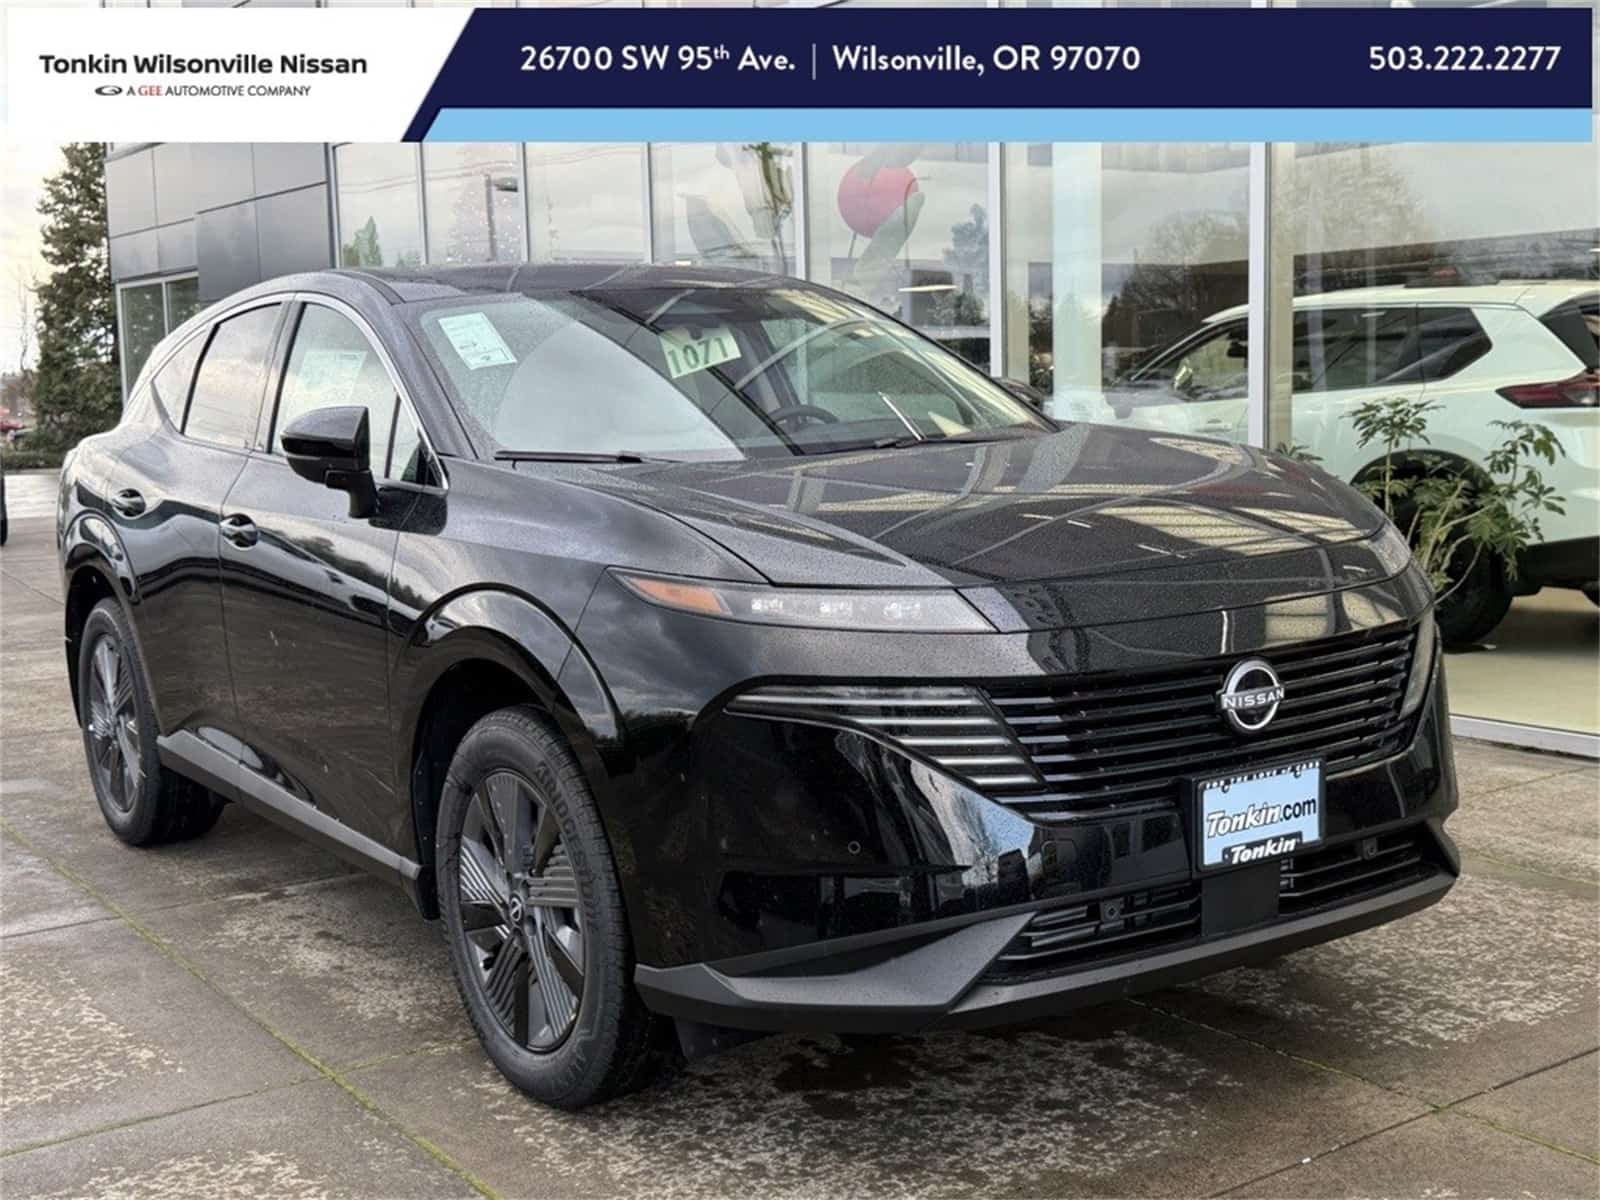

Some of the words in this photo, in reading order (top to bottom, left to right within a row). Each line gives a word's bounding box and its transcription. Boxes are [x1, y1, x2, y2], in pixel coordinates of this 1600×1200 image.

[667, 338, 731, 376] 1071
[1221, 690, 1285, 708] NISSAN
[1206, 797, 1317, 838] Tonkin.com
[1230, 837, 1296, 865] Tonkin
